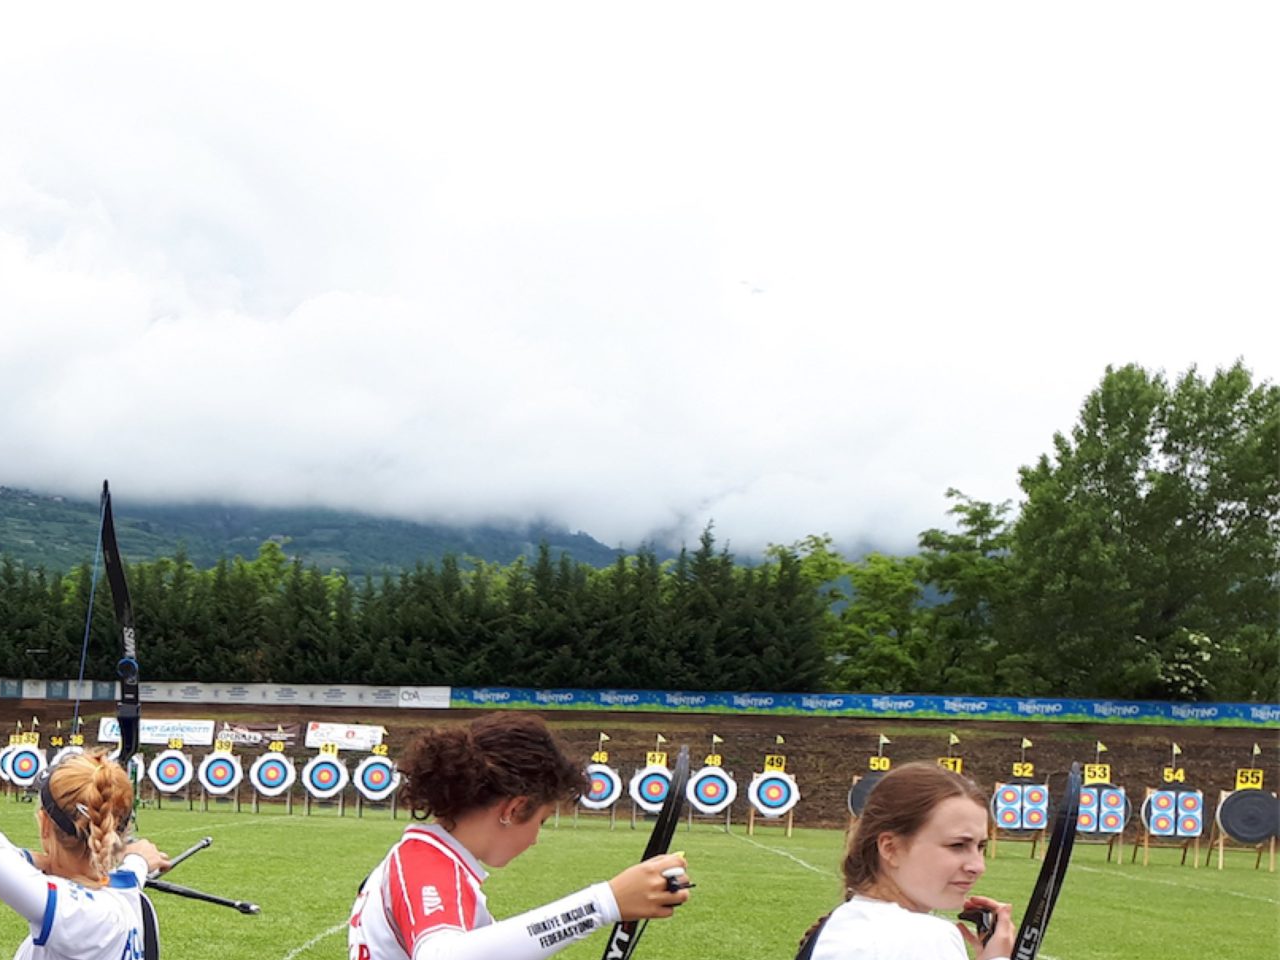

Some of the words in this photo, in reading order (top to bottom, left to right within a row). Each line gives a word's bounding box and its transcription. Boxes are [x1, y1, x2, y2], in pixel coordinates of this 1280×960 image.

[473, 691, 510, 702] TRENTINO
[535, 692, 573, 703] TRENTINO
[599, 692, 639, 704] TRENTINO
[666, 693, 705, 705] TRENTINO
[733, 694, 773, 707] TRENTINO
[802, 696, 843, 709] TRENTINO
[872, 698, 915, 711] TRENTINO
[944, 699, 987, 712] TRENTINO
[1017, 701, 1062, 714] TRENTINO
[1094, 703, 1139, 717] TRENTINO
[1171, 704, 1218, 719] TRENTINO
[23, 733, 37, 743] 35
[216, 740, 231, 750] 39
[321, 743, 336, 753] 41
[372, 744, 388, 755] 42
[591, 751, 608, 763] 46
[648, 753, 664, 764] 47
[705, 754, 721, 765] 48
[766, 756, 782, 768] 49
[870, 756, 890, 771] 50
[1013, 762, 1033, 777] 52
[1087, 766, 1108, 779] 53
[1163, 767, 1185, 783] 54
[1239, 772, 1261, 785] 55
